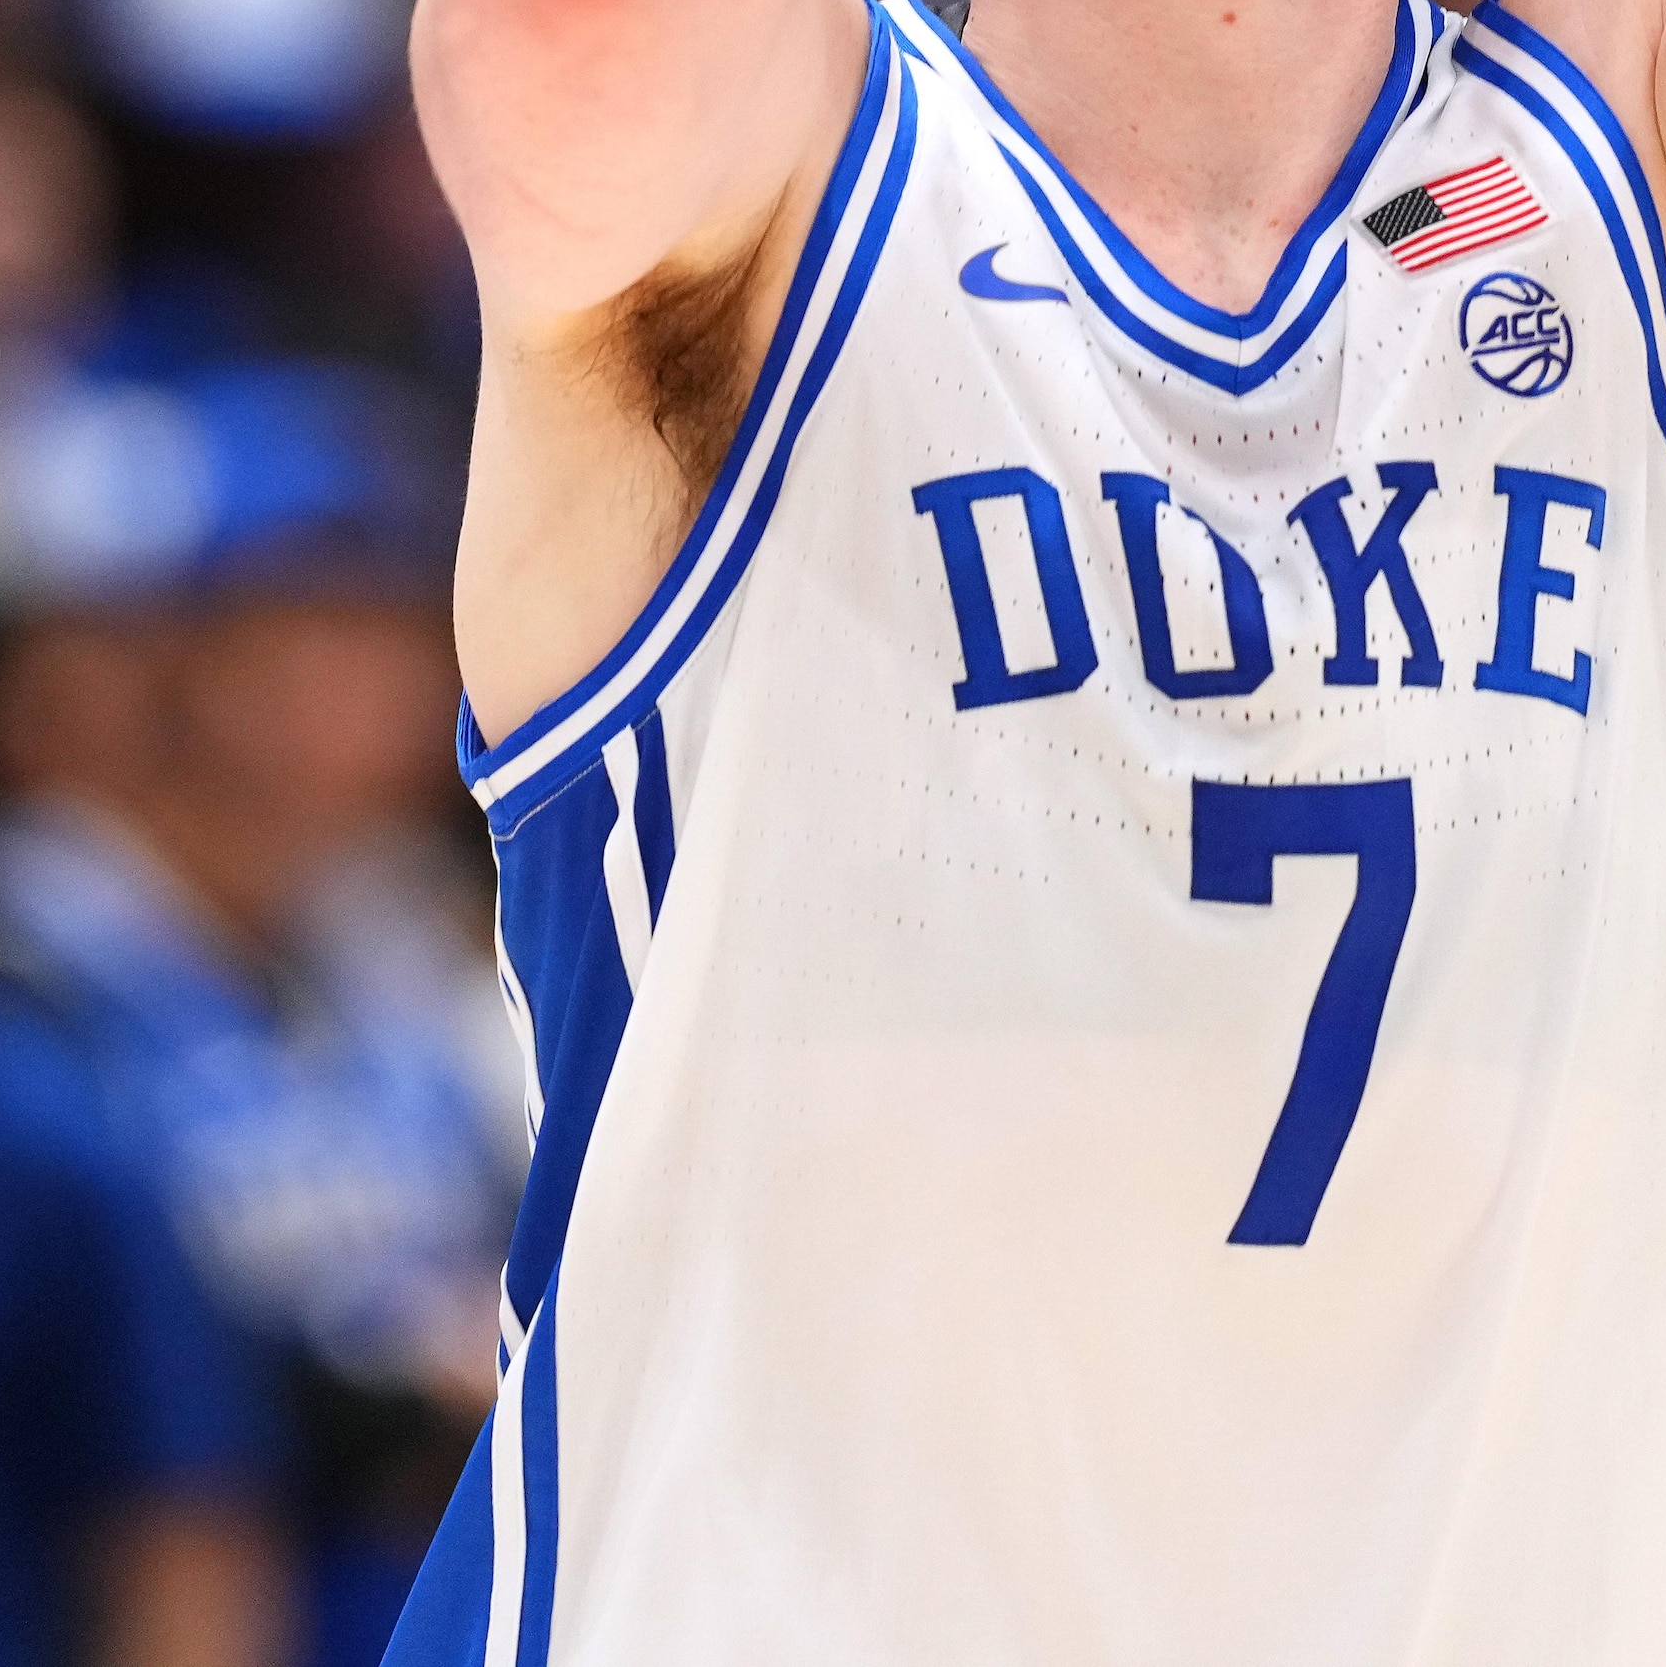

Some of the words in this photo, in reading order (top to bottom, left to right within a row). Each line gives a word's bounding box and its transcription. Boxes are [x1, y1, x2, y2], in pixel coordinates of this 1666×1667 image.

[1478, 305, 1560, 345] ACC
[910, 460, 1607, 718] DUKE
[1189, 776, 1417, 1247] 7
